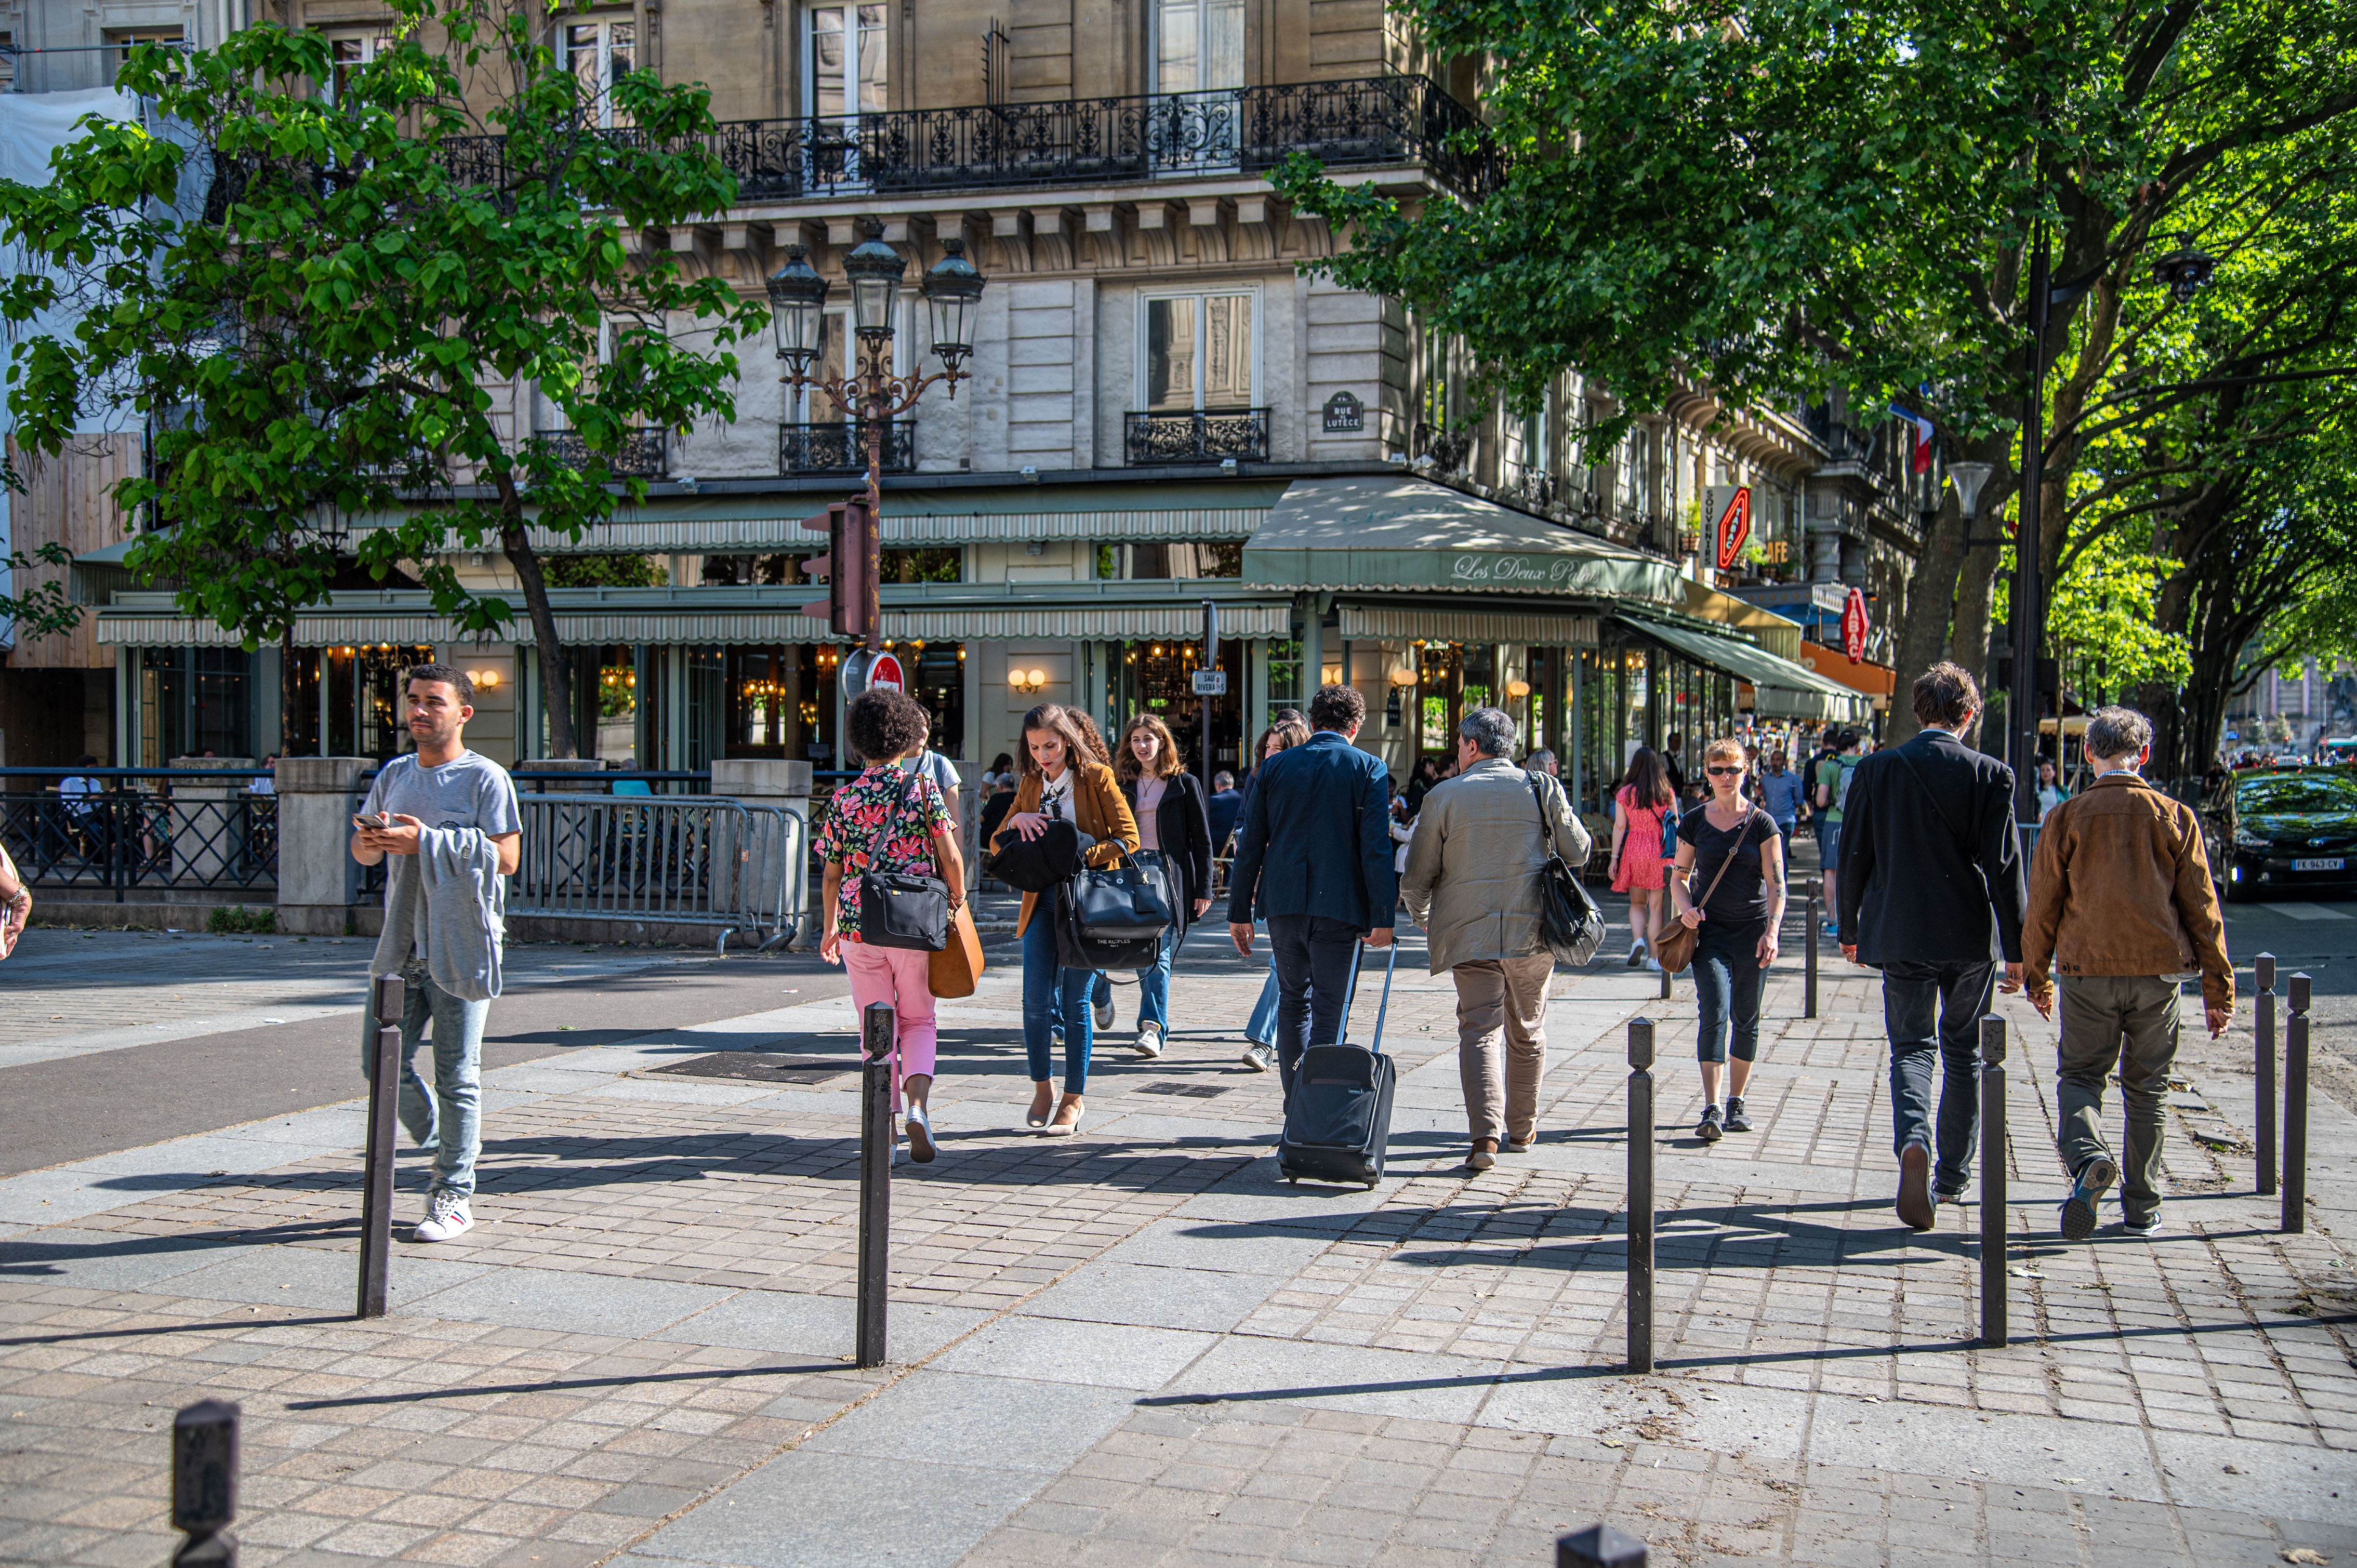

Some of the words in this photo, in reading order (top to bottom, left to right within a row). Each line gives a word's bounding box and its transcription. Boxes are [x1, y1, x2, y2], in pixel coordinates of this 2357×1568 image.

[1705, 489, 1714, 565] SOUVENIRS
[1726, 507, 1742, 549] TABAC
[1451, 555, 1489, 580] Les
[1493, 556, 1545, 580] Deux
[1550, 558, 1600, 583] Palais
[1767, 541, 1788, 564] AFE
[1848, 595, 1860, 658] TABAC
